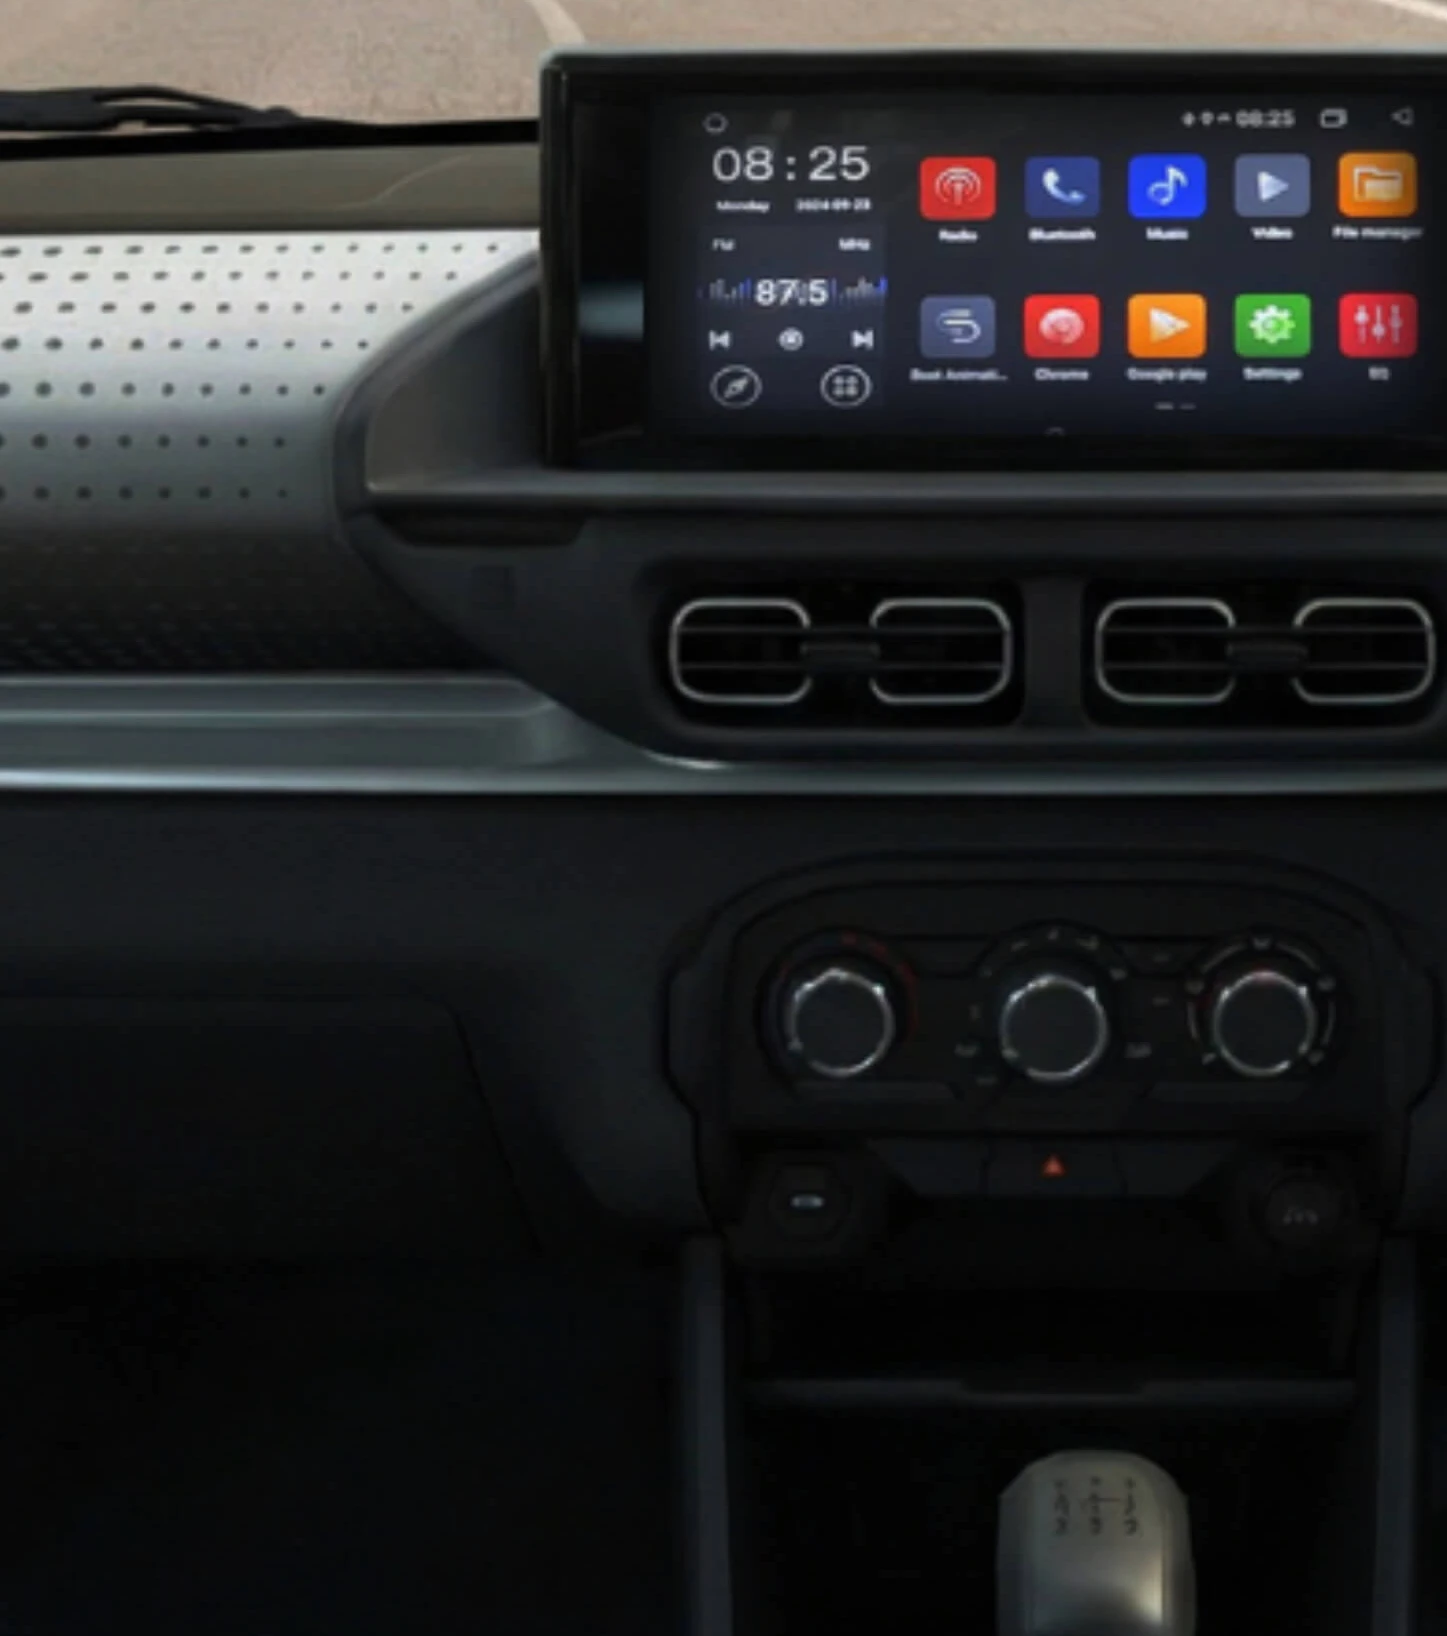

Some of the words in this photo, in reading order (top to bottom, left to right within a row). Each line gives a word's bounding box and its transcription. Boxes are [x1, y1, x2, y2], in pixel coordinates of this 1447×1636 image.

[716, 200, 770, 214] Monday
[938, 229, 978, 242] Radio
[1028, 227, 1097, 241] Bluetooth
[1146, 226, 1189, 240] Music
[1252, 225, 1294, 240] Video
[755, 277, 829, 306] 87.5
[1034, 367, 1090, 381] Chrome
[1126, 366, 1176, 382] Google
[1243, 366, 1303, 382] Settings
